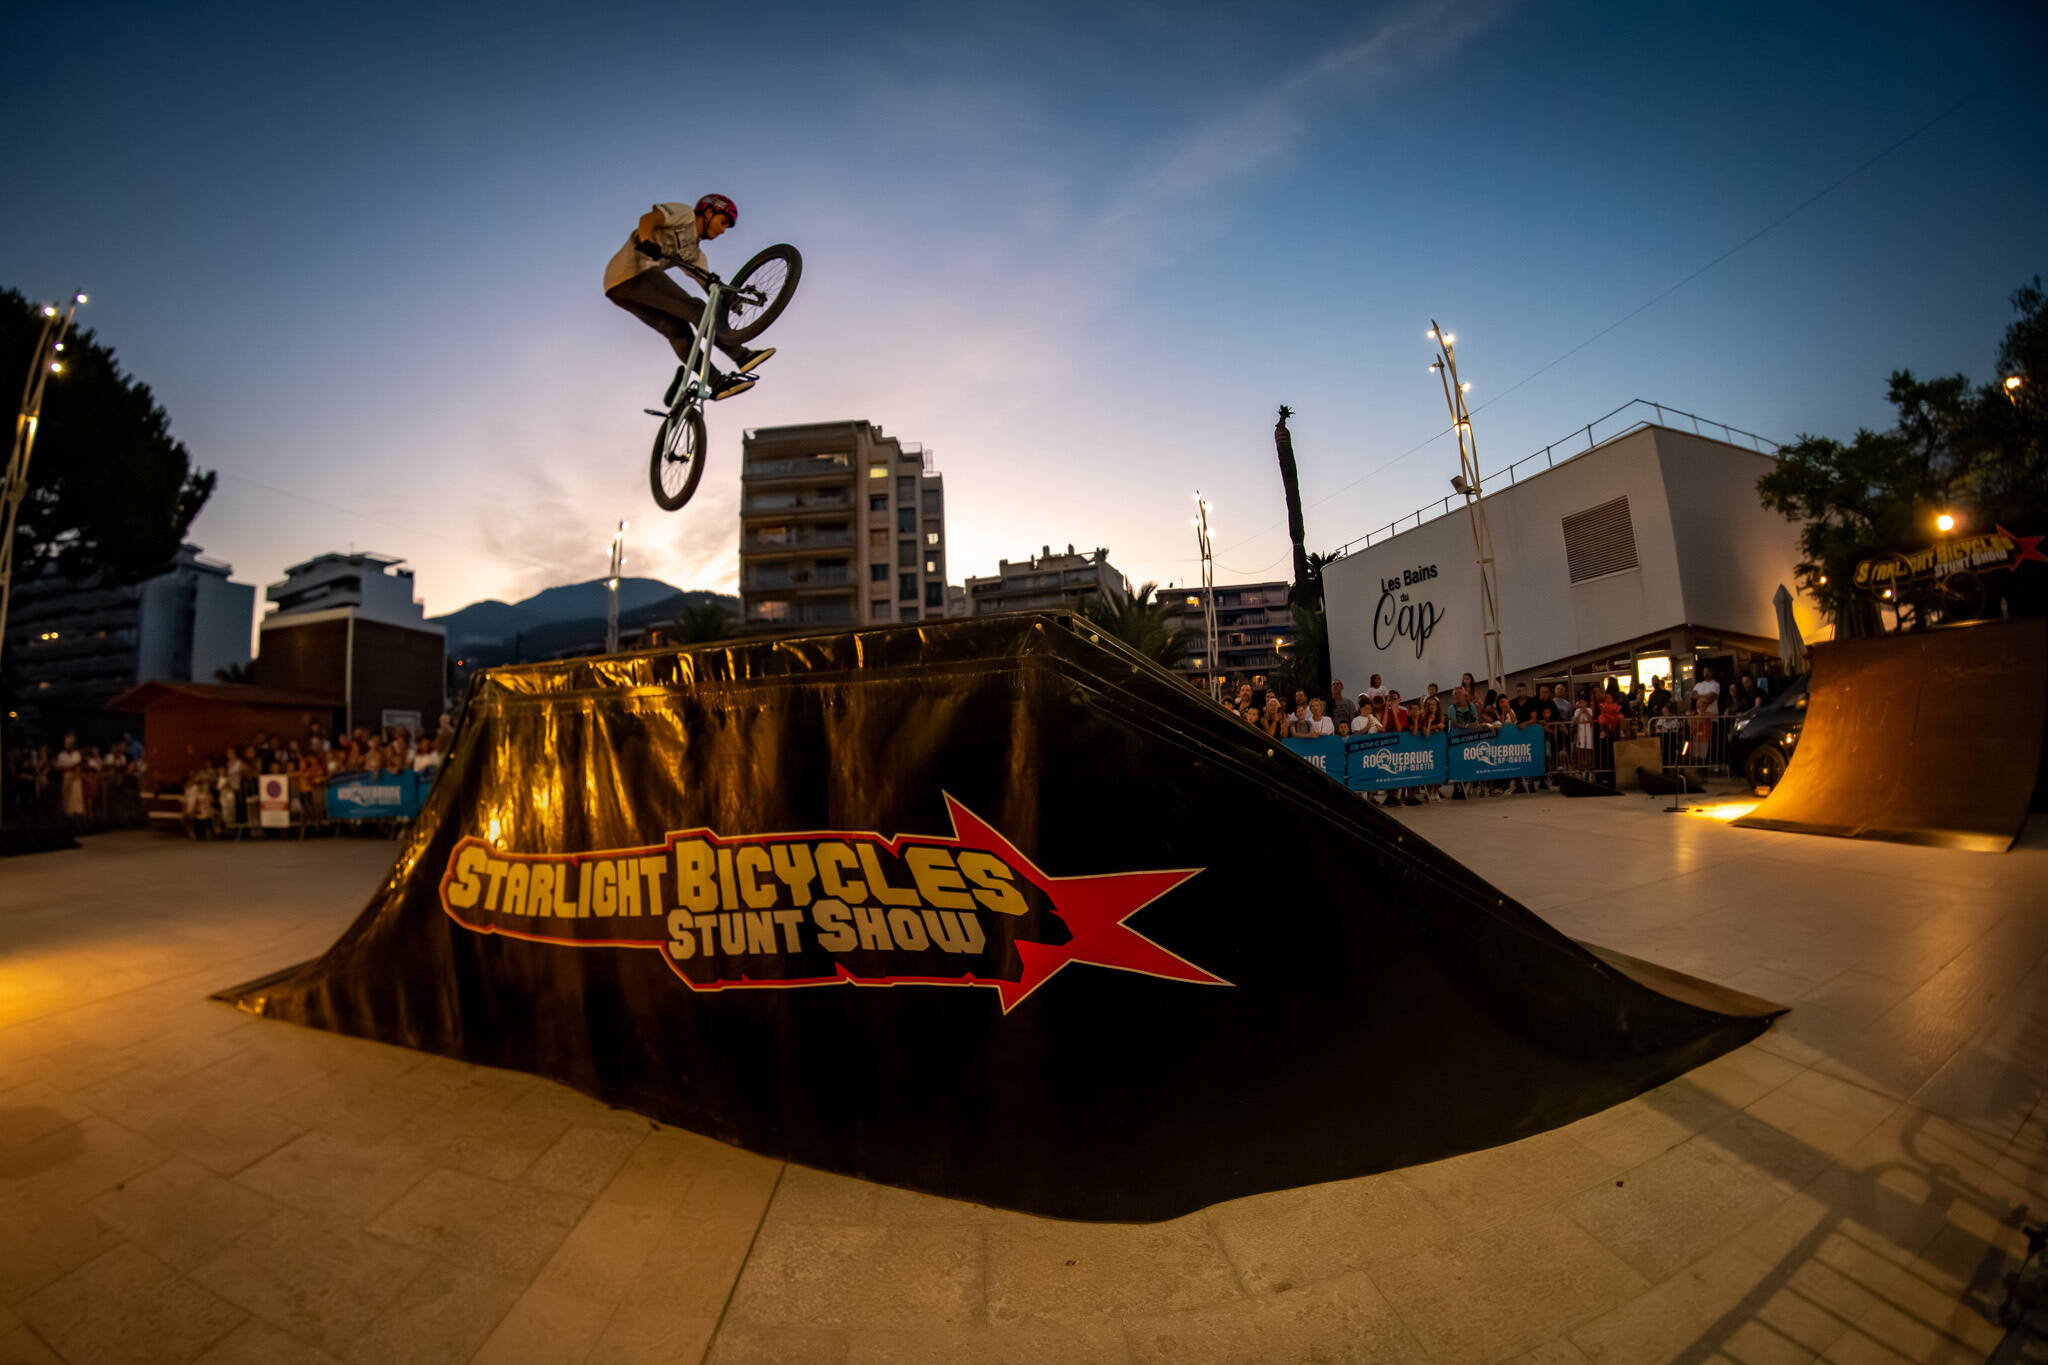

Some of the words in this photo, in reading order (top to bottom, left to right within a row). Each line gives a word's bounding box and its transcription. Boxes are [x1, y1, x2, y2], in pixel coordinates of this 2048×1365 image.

[1381, 577, 1401, 594] Les
[1403, 564, 1438, 587] Bains
[1400, 592, 1410, 603] du
[1373, 592, 1445, 660] Cap
[1362, 748, 1434, 773] ROQUEBRUNE
[1463, 742, 1532, 766] ROQUEBRUNE
[447, 846, 668, 919] STARLIGHT
[675, 838, 1031, 918] BICYCLES
[667, 909, 803, 961] STUNT
[812, 898, 987, 957] SHOW
